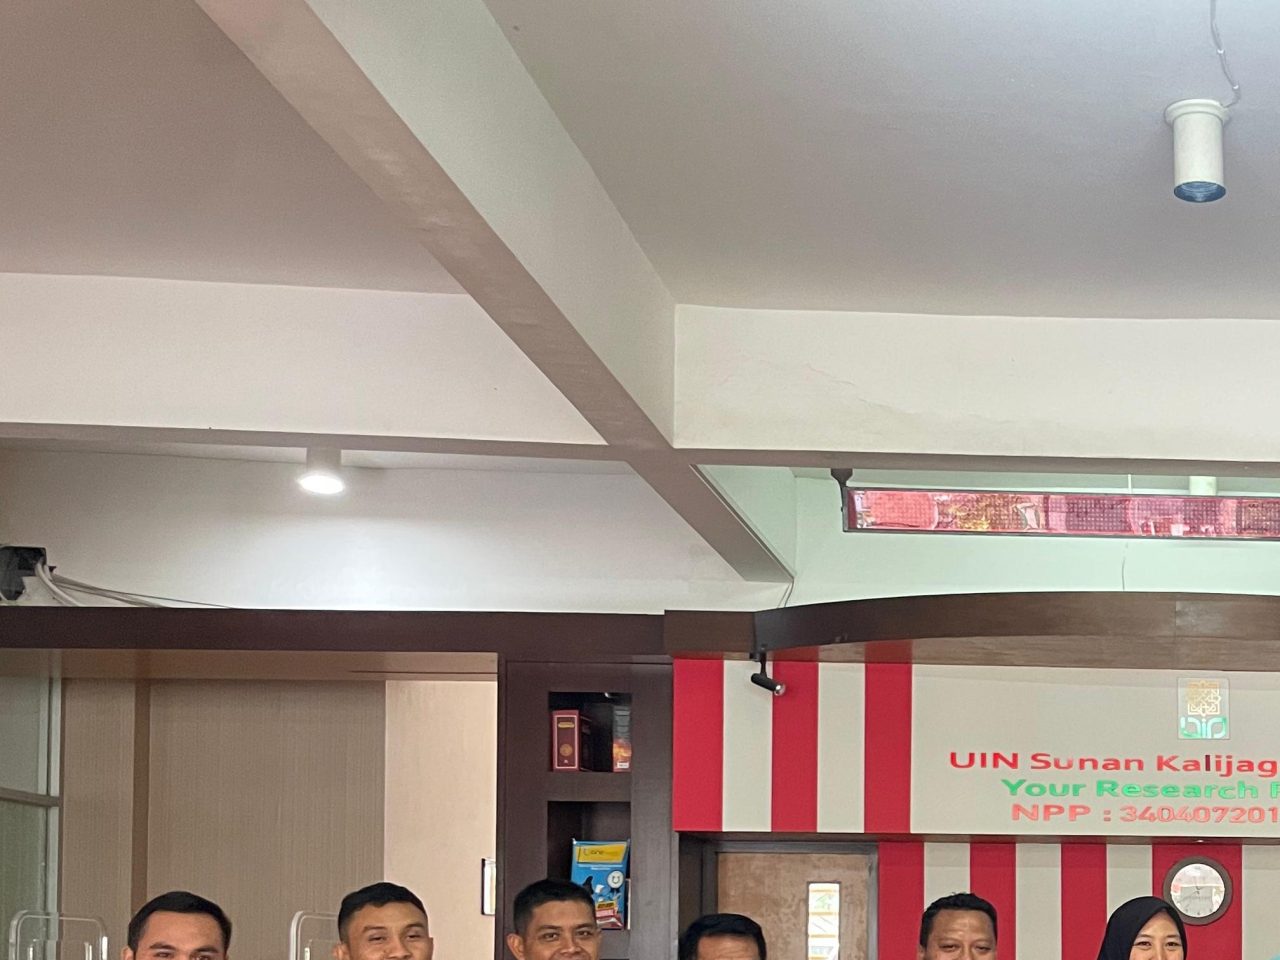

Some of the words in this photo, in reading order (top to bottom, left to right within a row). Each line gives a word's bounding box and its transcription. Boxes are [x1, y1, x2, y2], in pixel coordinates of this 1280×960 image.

[949, 751, 1019, 769] UIN
[1030, 752, 1144, 771] Sunan
[1001, 778, 1087, 797] Your
[1096, 779, 1259, 800] Research
[1011, 803, 1091, 822] NPP
